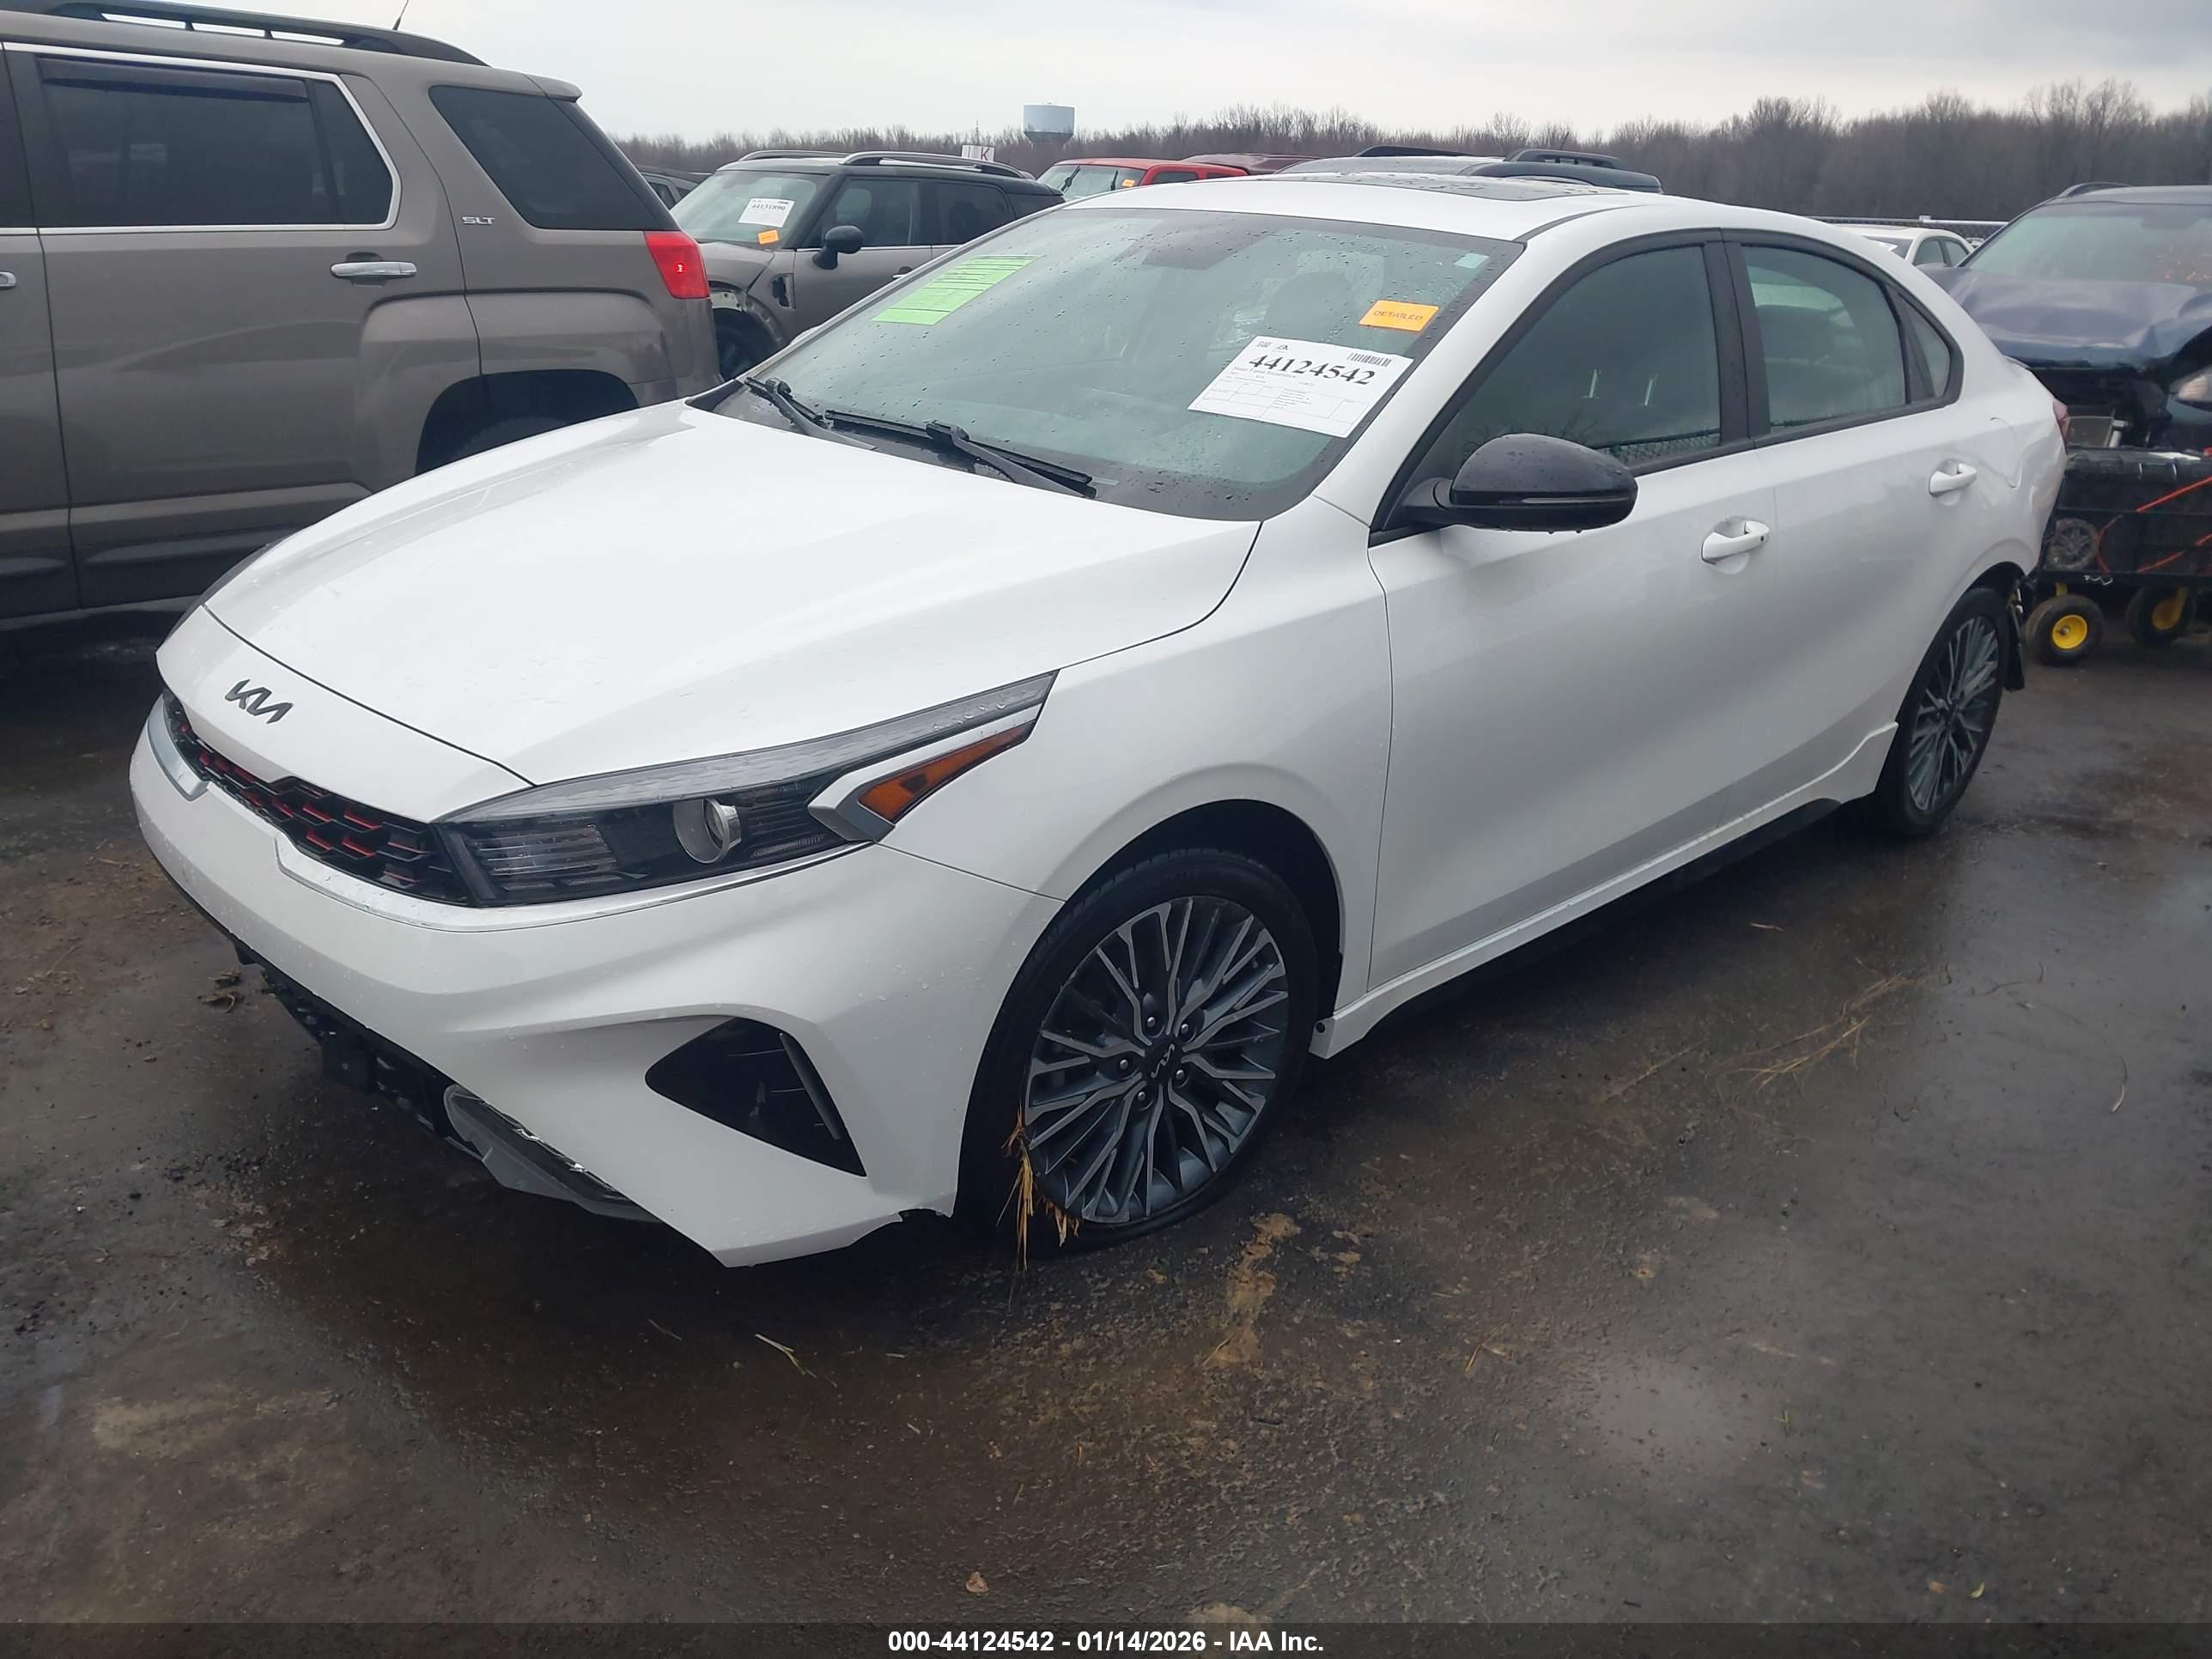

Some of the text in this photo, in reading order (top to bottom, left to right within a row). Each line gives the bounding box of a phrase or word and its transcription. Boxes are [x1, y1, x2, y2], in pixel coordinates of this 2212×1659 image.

[462, 216, 495, 225] SLT
[1374, 311, 1423, 320] DETAILED
[1249, 355, 1376, 385] 44124542
[225, 678, 294, 724] KIA
